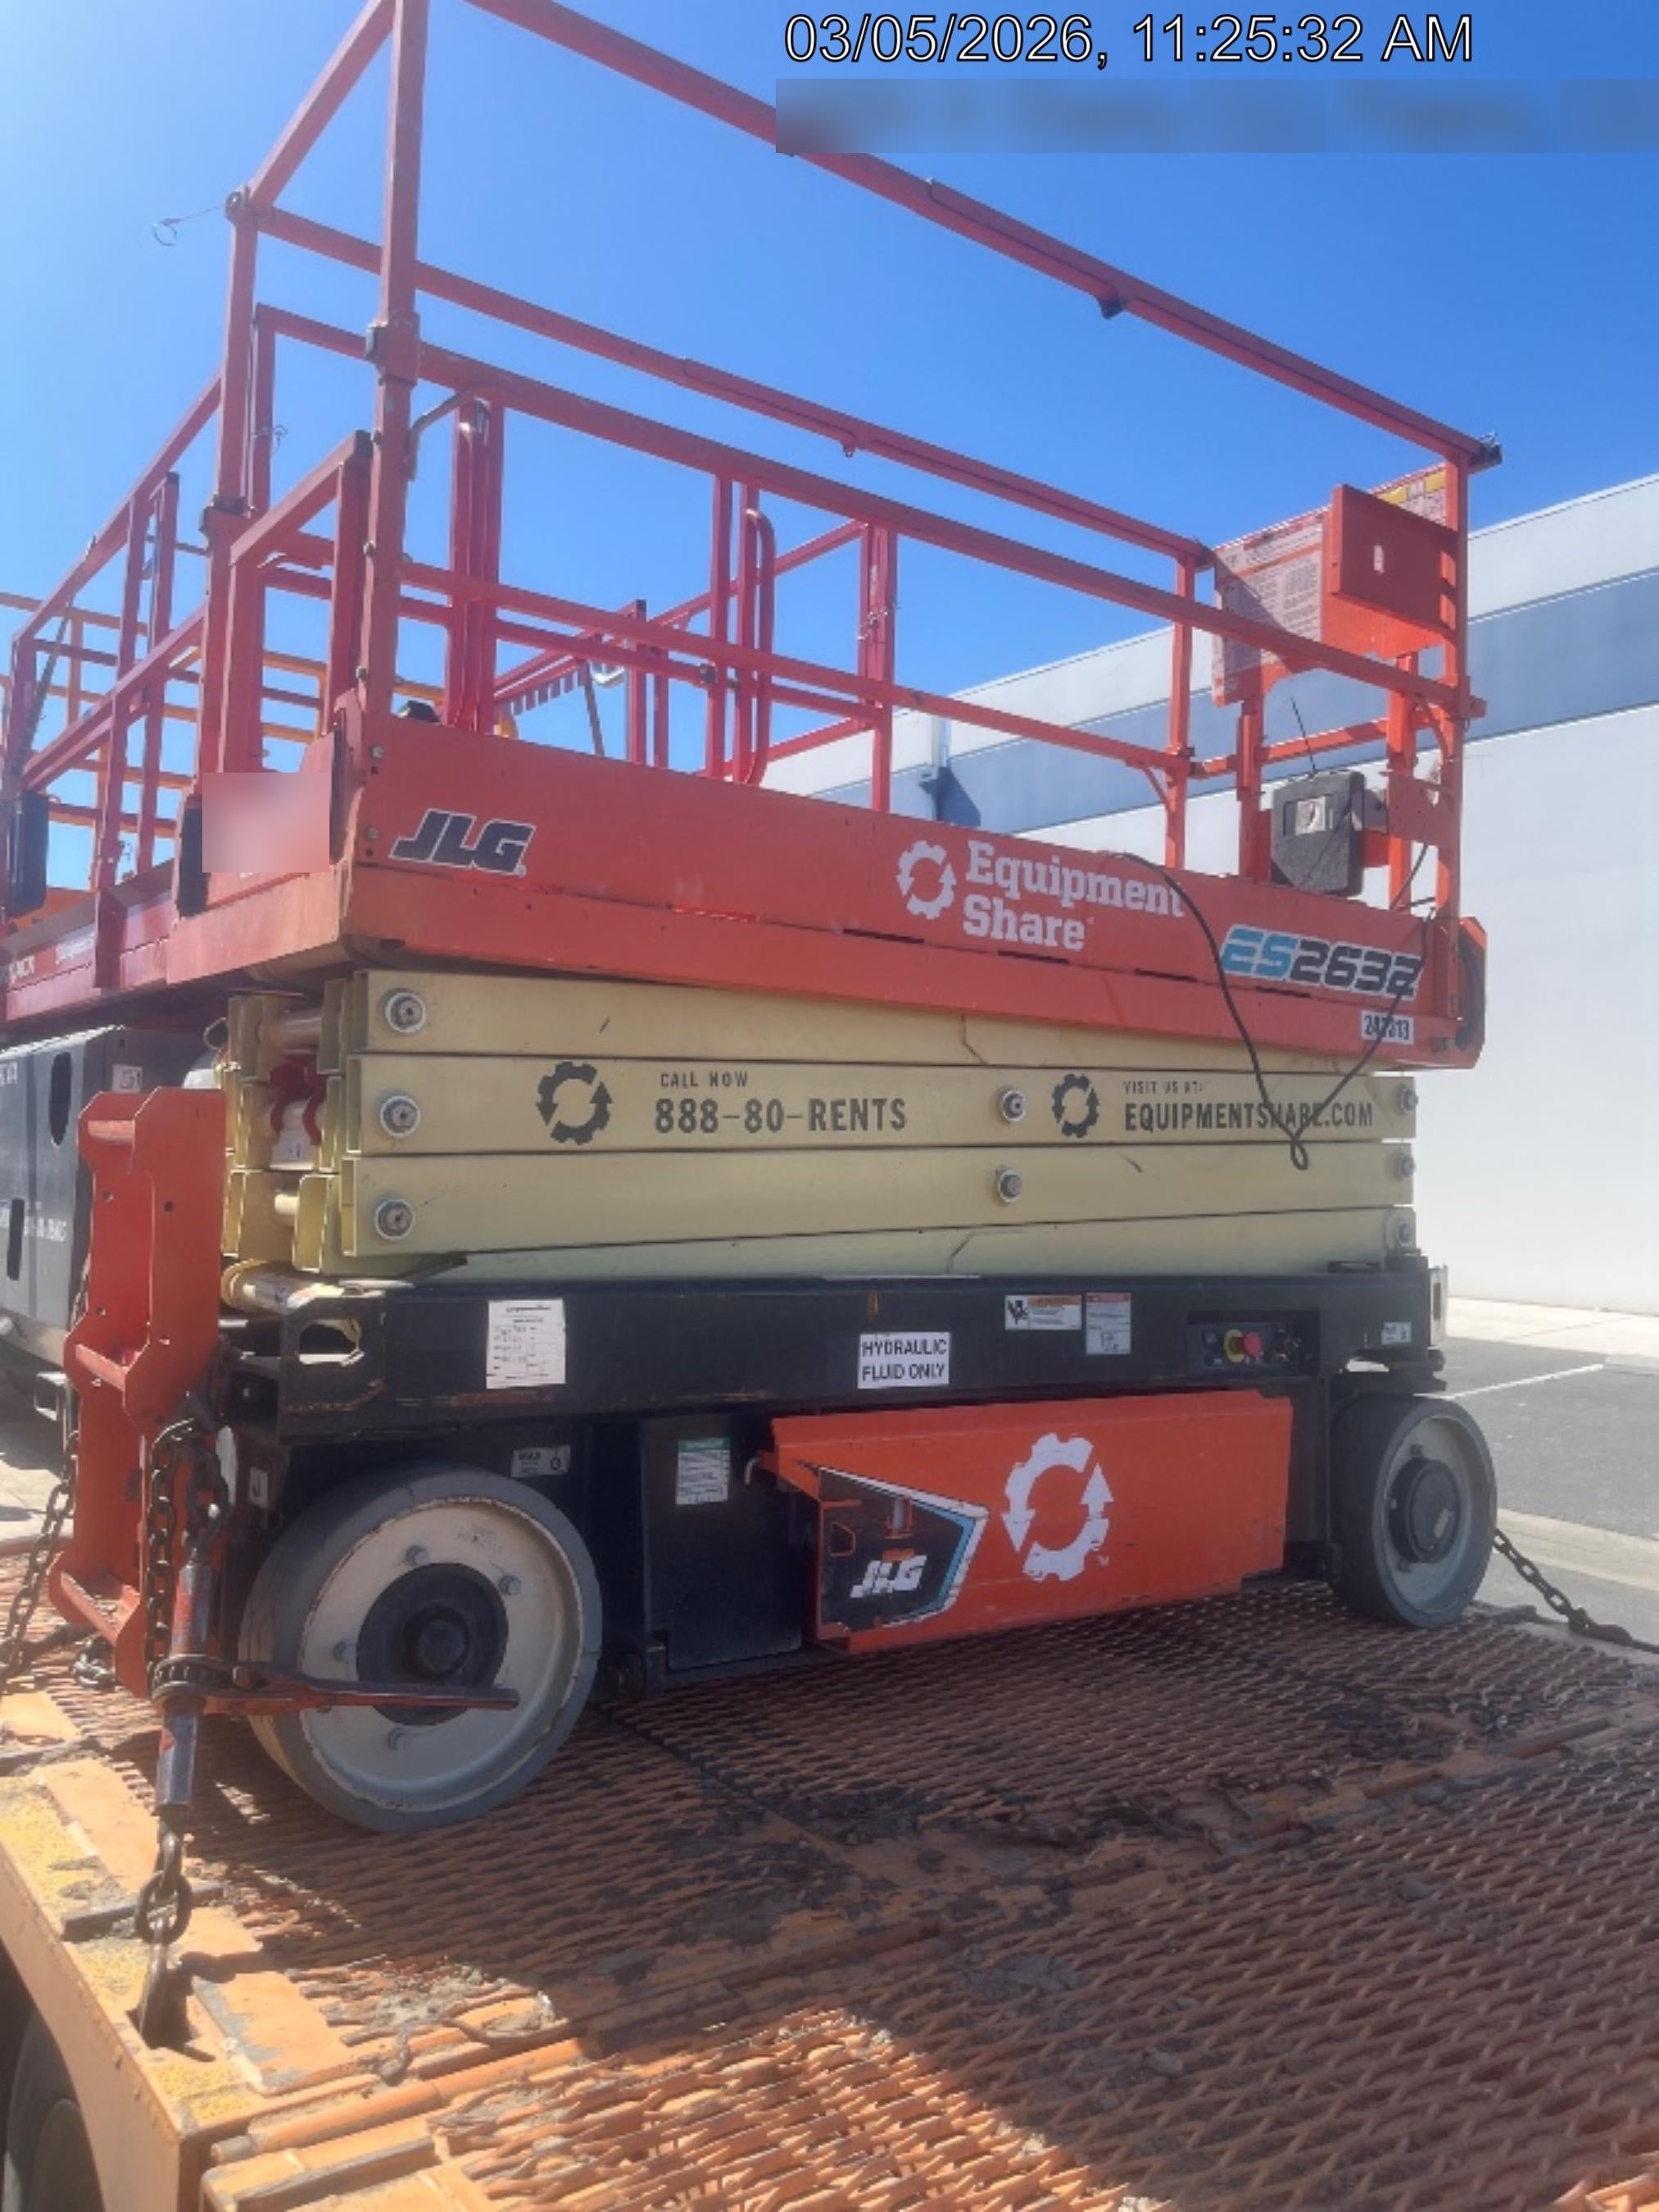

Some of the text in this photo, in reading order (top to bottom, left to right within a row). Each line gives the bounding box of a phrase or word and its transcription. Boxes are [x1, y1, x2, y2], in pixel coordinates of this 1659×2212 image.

[390, 808, 537, 877] JLG
[966, 841, 1185, 918] Equipment
[963, 895, 1086, 950] Share
[1221, 924, 1423, 999] ES2632
[660, 1072, 747, 1088] CALL NOW
[1123, 1081, 1156, 1095] VISIT
[1163, 1081, 1179, 1094] US
[655, 1099, 905, 1134] 888-80-RENTS
[862, 1338, 947, 1357] HYDRAULIC
[862, 1362, 945, 1381] FLUID ONLY
[850, 1555, 927, 1598] JLG
